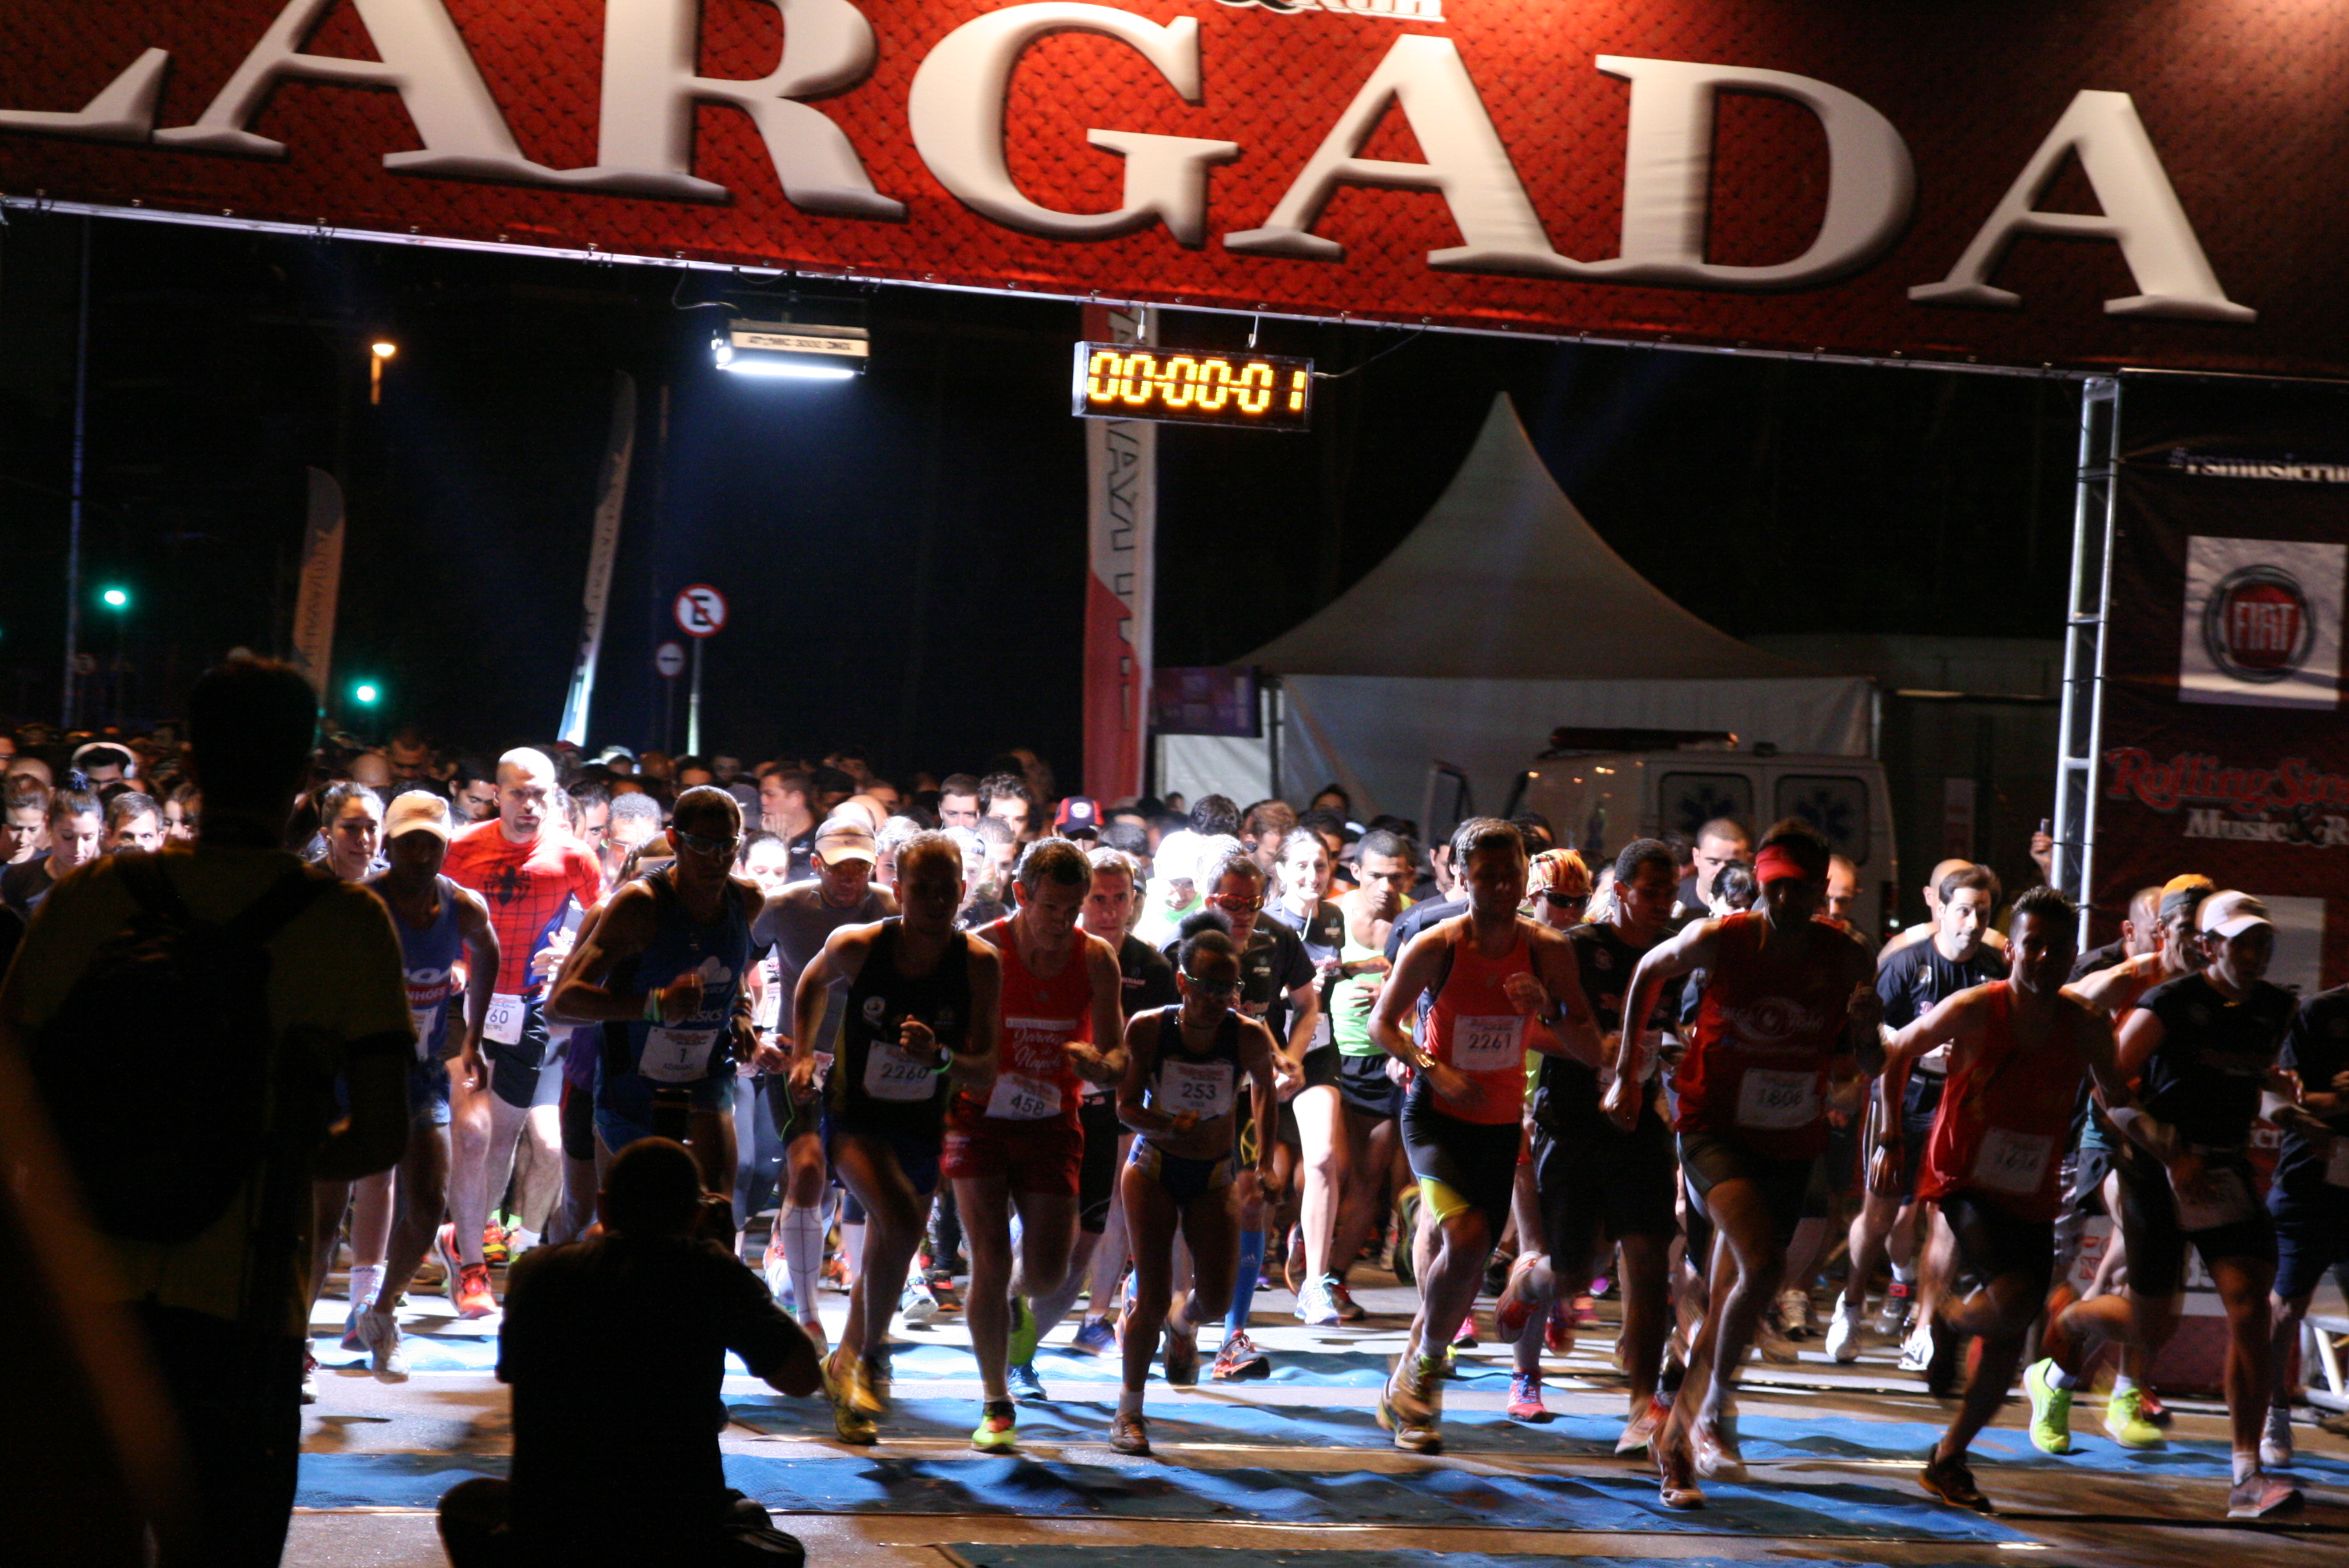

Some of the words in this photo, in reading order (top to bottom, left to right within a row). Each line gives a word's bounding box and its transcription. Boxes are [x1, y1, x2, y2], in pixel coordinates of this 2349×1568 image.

[2234, 601, 2296, 651] FIAT
[2106, 746, 2279, 816] Rolling
[2183, 807, 2291, 843] Music
[488, 1009, 510, 1025] 60
[1468, 1033, 1512, 1050] 2261
[880, 1063, 931, 1080] 2260
[1181, 1082, 1217, 1100] 253
[1010, 1094, 1045, 1116] 458
